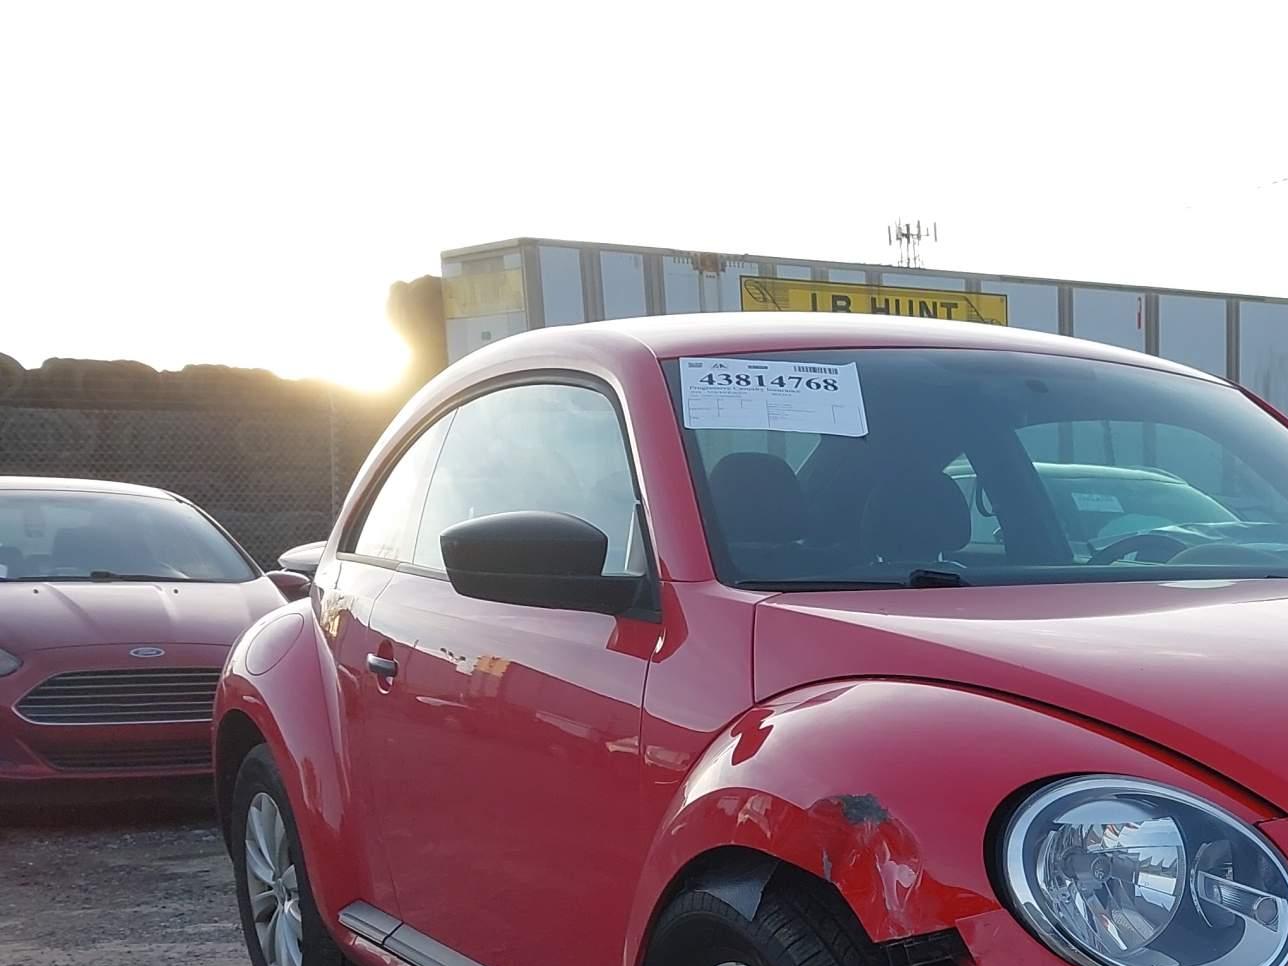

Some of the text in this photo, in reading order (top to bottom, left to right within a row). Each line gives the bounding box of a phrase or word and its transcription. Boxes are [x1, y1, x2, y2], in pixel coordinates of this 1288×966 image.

[831, 294, 852, 313] B
[870, 296, 959, 320] HUNT
[699, 372, 839, 392] 43814768
